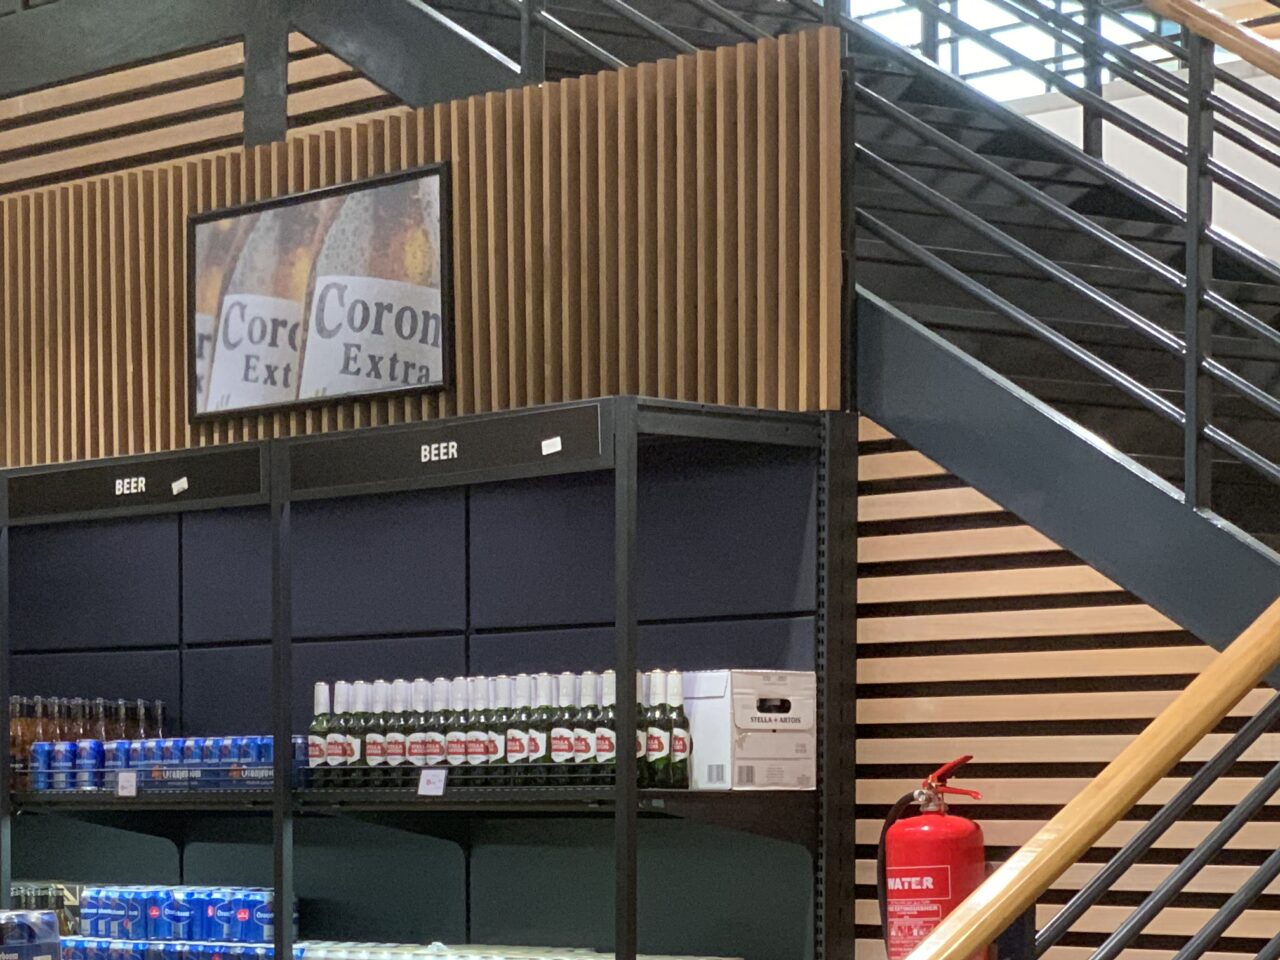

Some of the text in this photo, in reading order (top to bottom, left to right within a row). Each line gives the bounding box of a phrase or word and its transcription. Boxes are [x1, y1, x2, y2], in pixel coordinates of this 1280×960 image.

[314, 281, 441, 349] Coron
[242, 353, 292, 388] Ext
[339, 342, 431, 385] Extra
[420, 441, 459, 463] BEER
[115, 476, 147, 496] BEER
[887, 876, 935, 891] WATER
